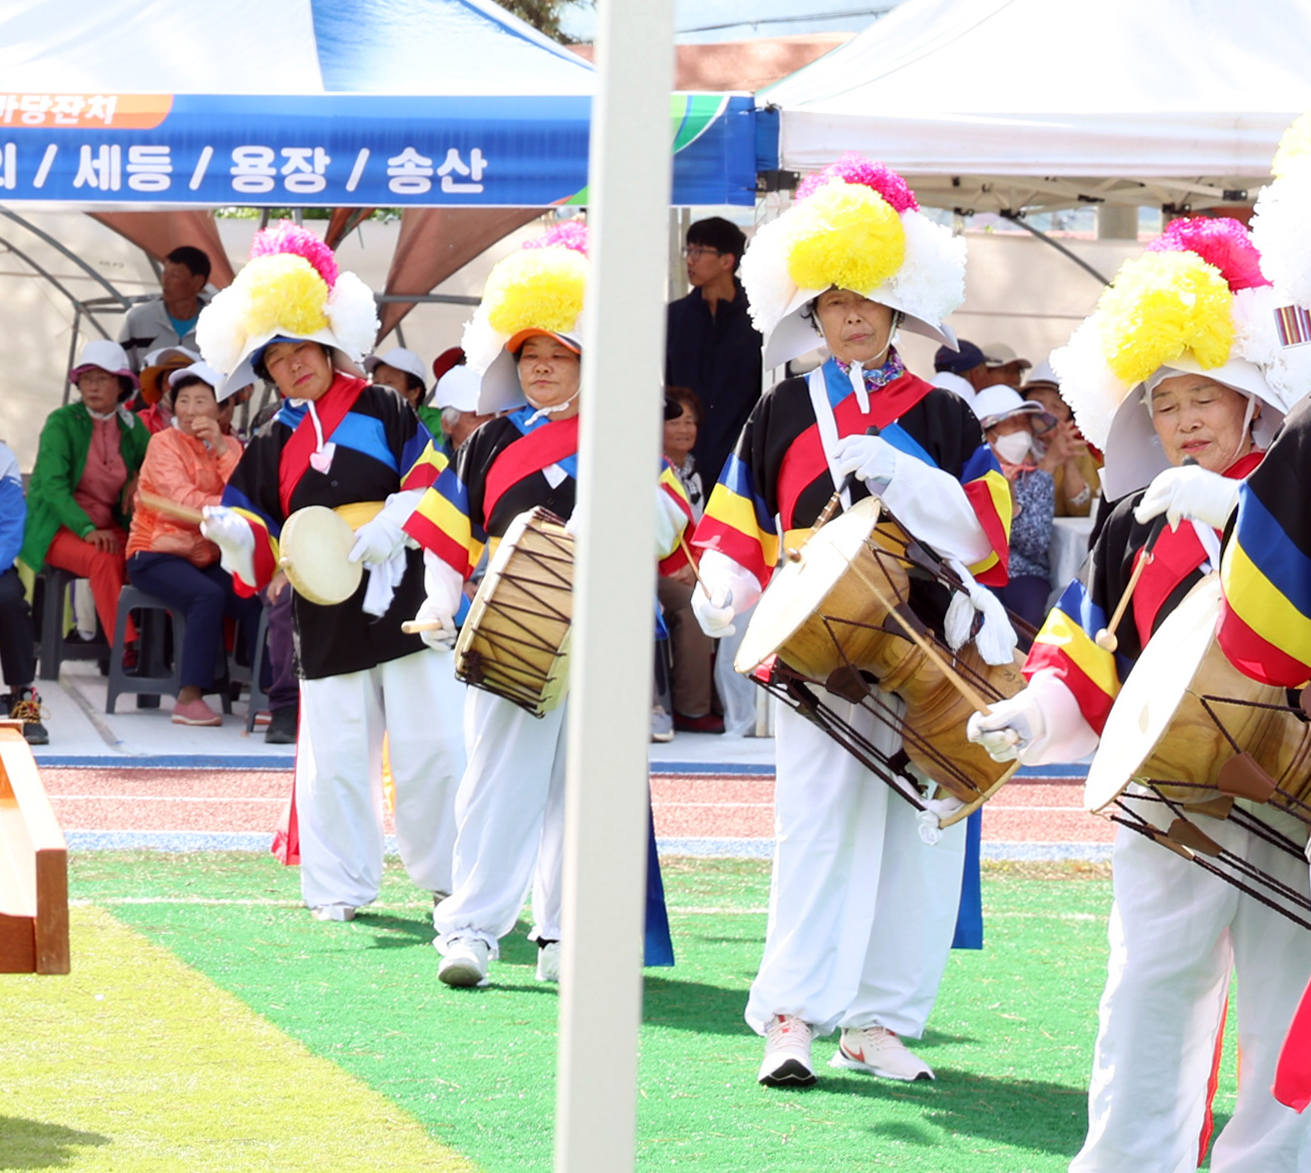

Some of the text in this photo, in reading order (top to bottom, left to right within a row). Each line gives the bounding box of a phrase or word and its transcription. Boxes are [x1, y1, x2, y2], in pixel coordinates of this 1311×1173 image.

[73, 143, 174, 193] 세등
[229, 144, 331, 194] 용장
[386, 146, 489, 195] 송산
